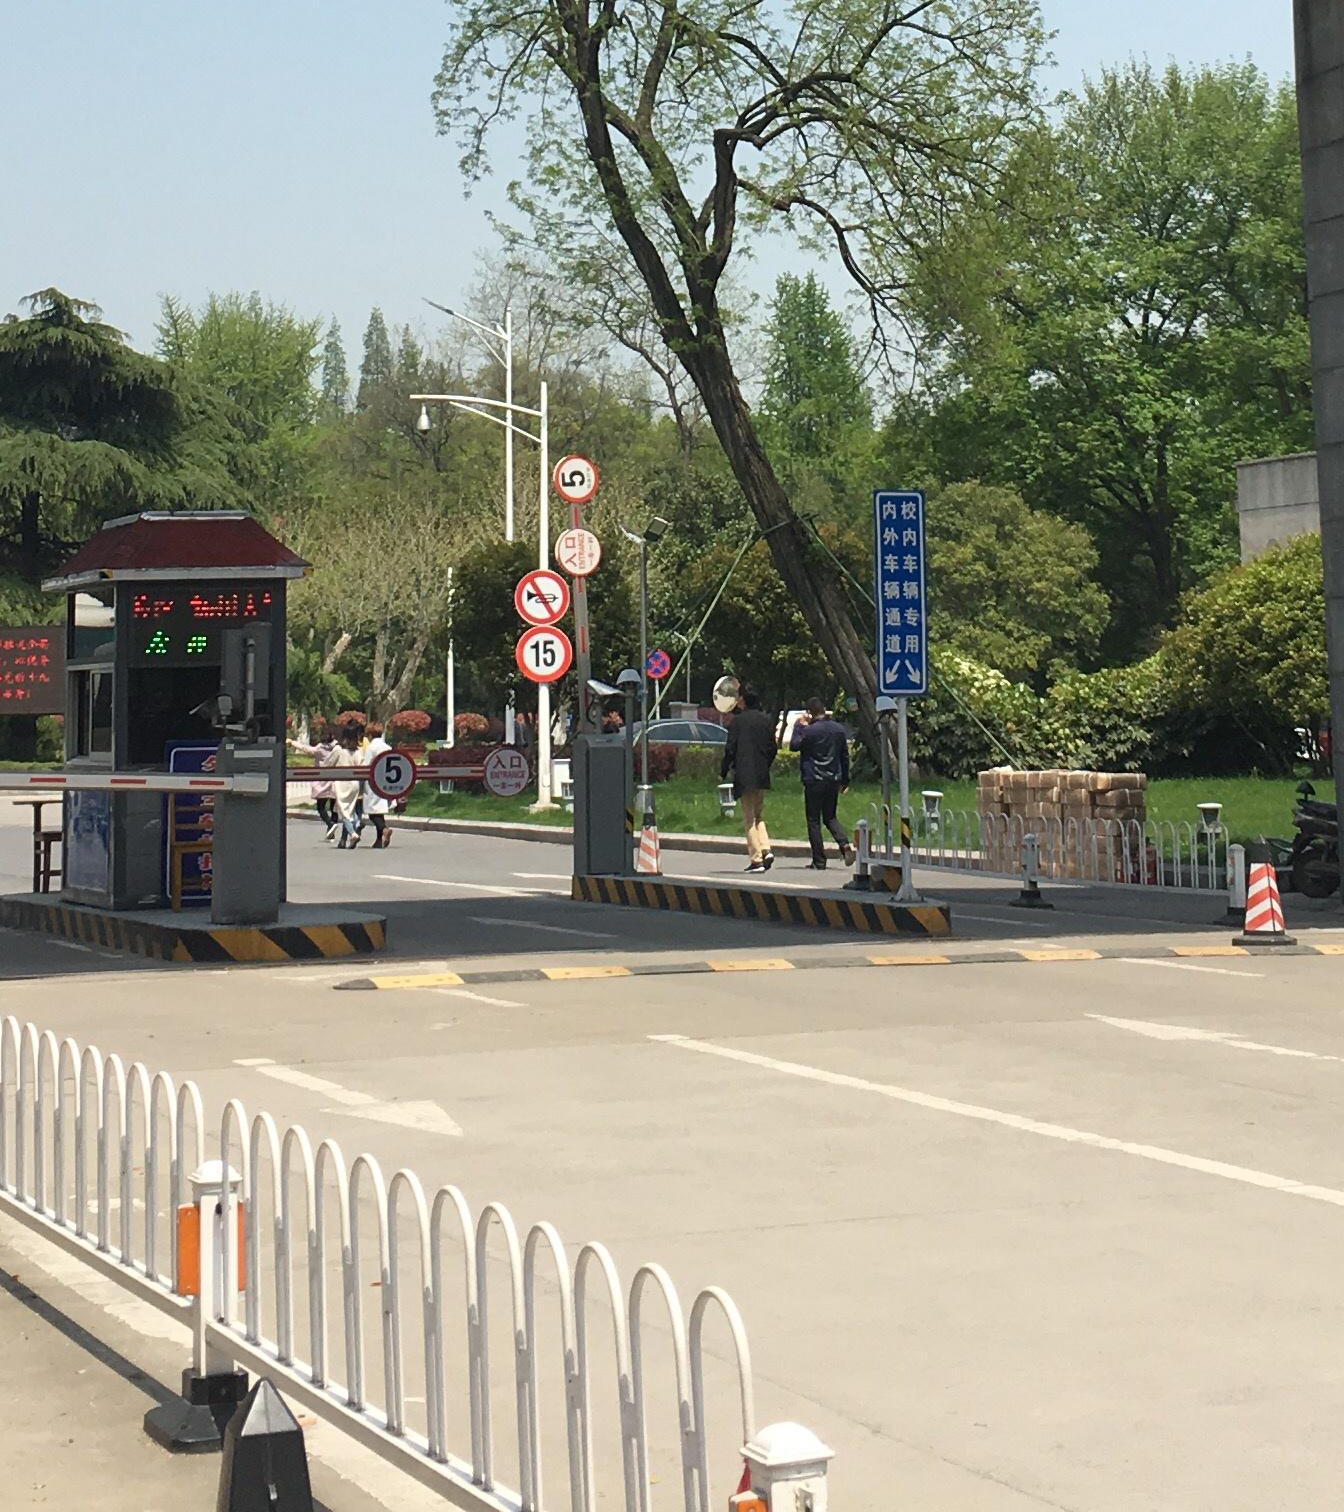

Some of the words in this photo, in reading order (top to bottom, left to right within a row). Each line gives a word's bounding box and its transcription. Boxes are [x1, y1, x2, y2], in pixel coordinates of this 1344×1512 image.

[561, 470, 585, 487] 5
[564, 536, 578, 568] 入口
[901, 501, 920, 654] 校内车辆专用
[530, 640, 556, 667] 15
[385, 756, 402, 784] 5
[492, 755, 522, 769] 入口
